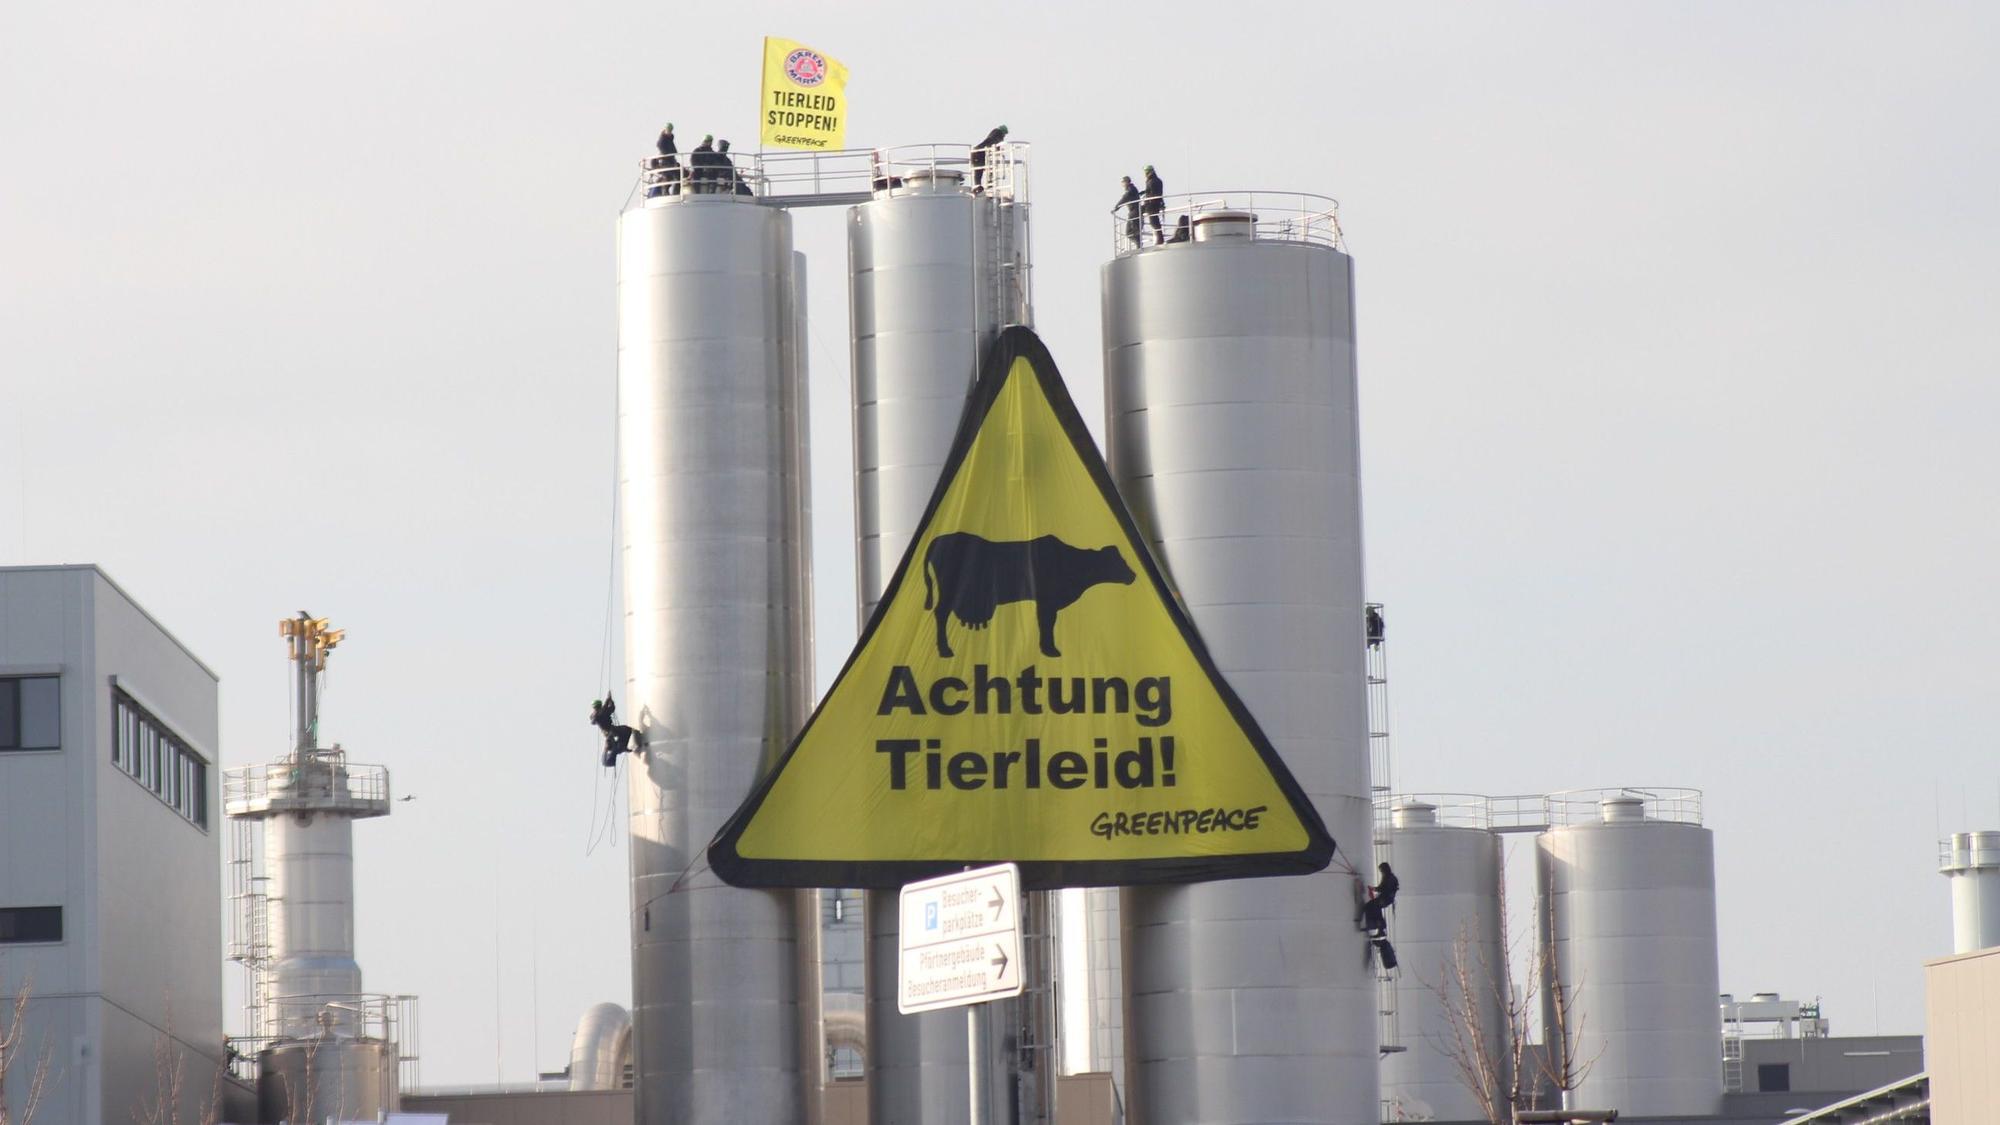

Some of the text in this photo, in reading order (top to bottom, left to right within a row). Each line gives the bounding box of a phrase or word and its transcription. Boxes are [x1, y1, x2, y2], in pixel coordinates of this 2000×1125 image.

[789, 69, 823, 84] MARKE
[773, 90, 835, 111] TIERLEID
[768, 110, 837, 132] STOPPEN!
[774, 134, 828, 147] GREENPEACE
[876, 664, 1172, 727] Achtung
[876, 736, 1176, 790] Tierleid!
[1090, 805, 1267, 840] GREENPEACE
[943, 913, 984, 937] parkplätze
[908, 971, 987, 998] Besucheranmeldung
